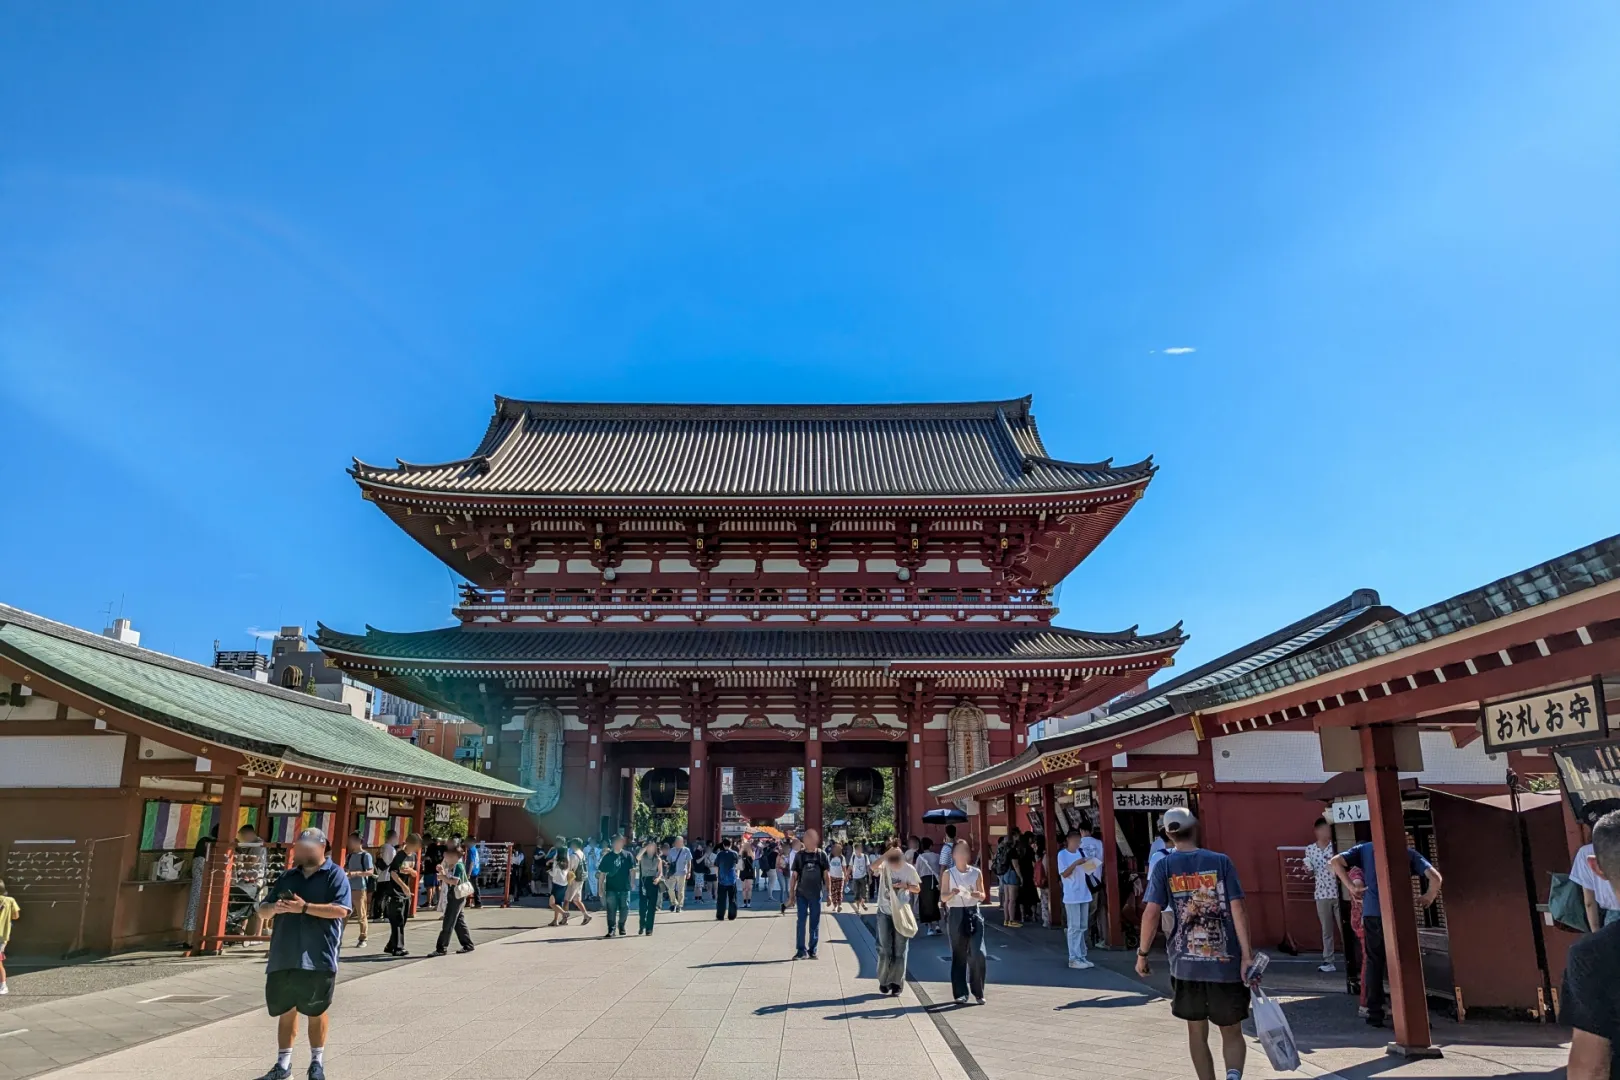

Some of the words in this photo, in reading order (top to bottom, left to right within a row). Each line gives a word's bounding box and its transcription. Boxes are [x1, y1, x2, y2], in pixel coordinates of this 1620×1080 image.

[1496, 693, 1592, 741] お札お守
[270, 792, 298, 809] みくじ
[368, 800, 387, 814] みくじ
[1116, 793, 1185, 806] 古札お納め所
[1338, 804, 1362, 820] みくじ
